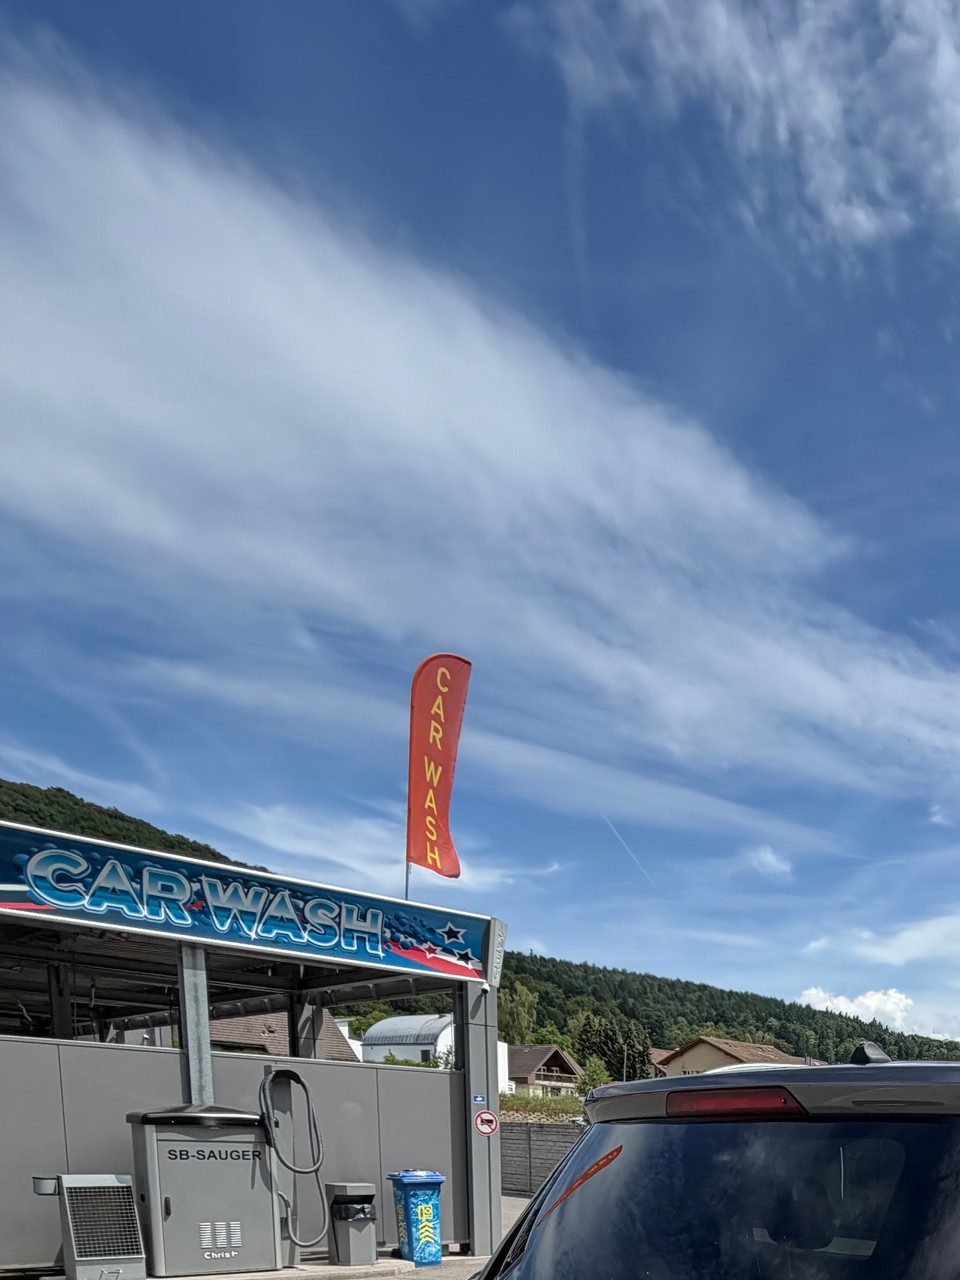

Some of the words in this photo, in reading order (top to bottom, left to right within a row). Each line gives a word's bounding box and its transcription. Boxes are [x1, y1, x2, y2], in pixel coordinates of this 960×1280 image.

[429, 666, 451, 750] CAR
[424, 755, 442, 869] WASH
[26, 848, 194, 927] CAR
[200, 873, 387, 959] WASH
[167, 1149, 263, 1161] SB-SAUGER
[203, 1250, 239, 1260] Christ
